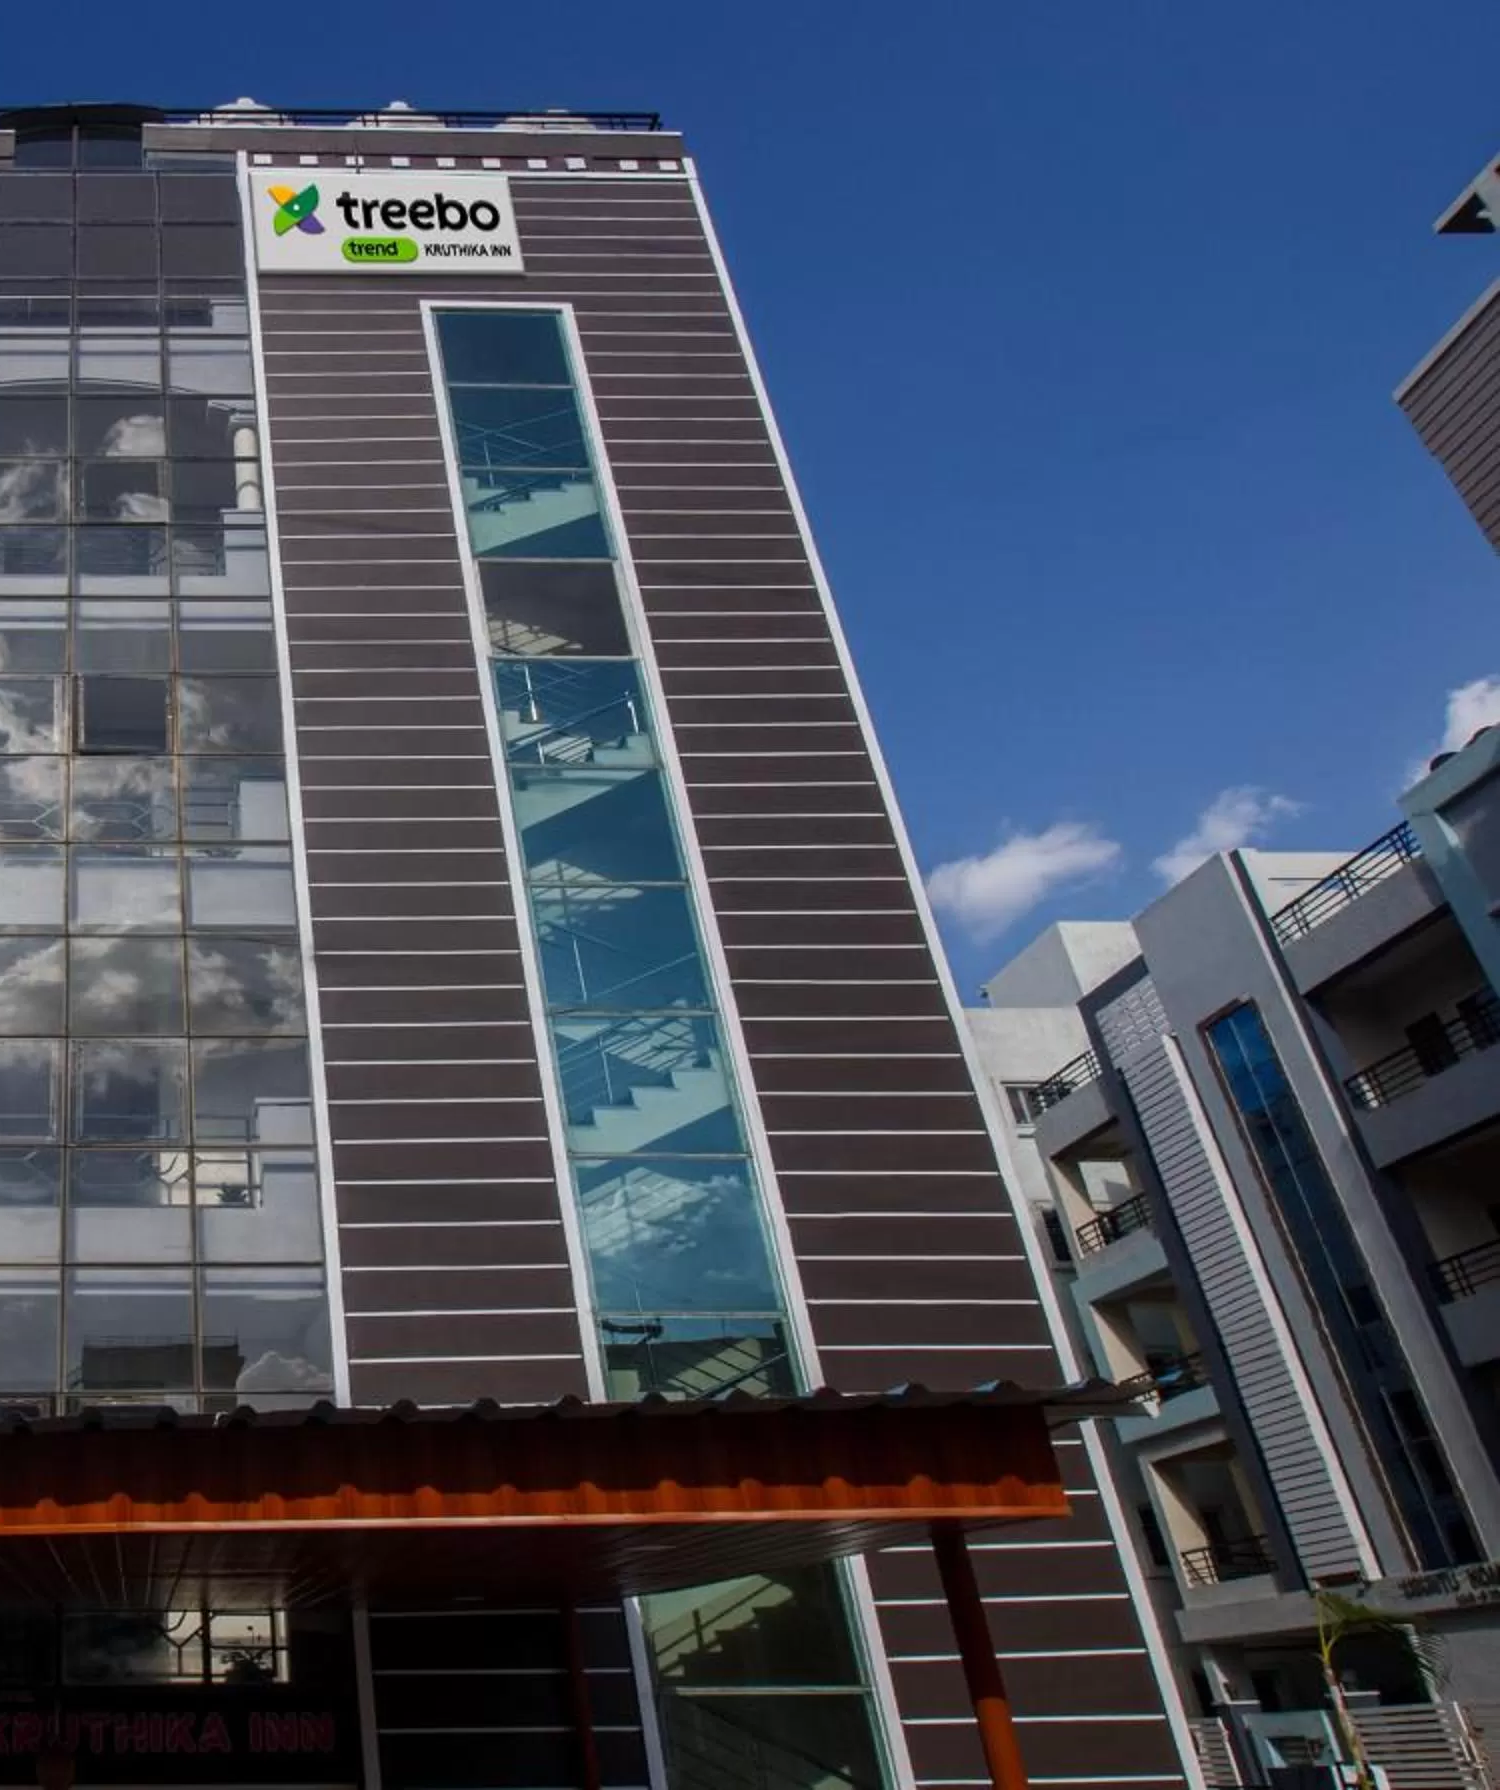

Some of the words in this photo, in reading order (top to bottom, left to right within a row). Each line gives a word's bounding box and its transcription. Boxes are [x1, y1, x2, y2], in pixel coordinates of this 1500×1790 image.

[336, 191, 500, 231] treebo
[348, 241, 398, 256] trend
[424, 243, 489, 257] KRUTHIKA
[490, 243, 512, 257] INN
[248, 1711, 337, 1754] INN
